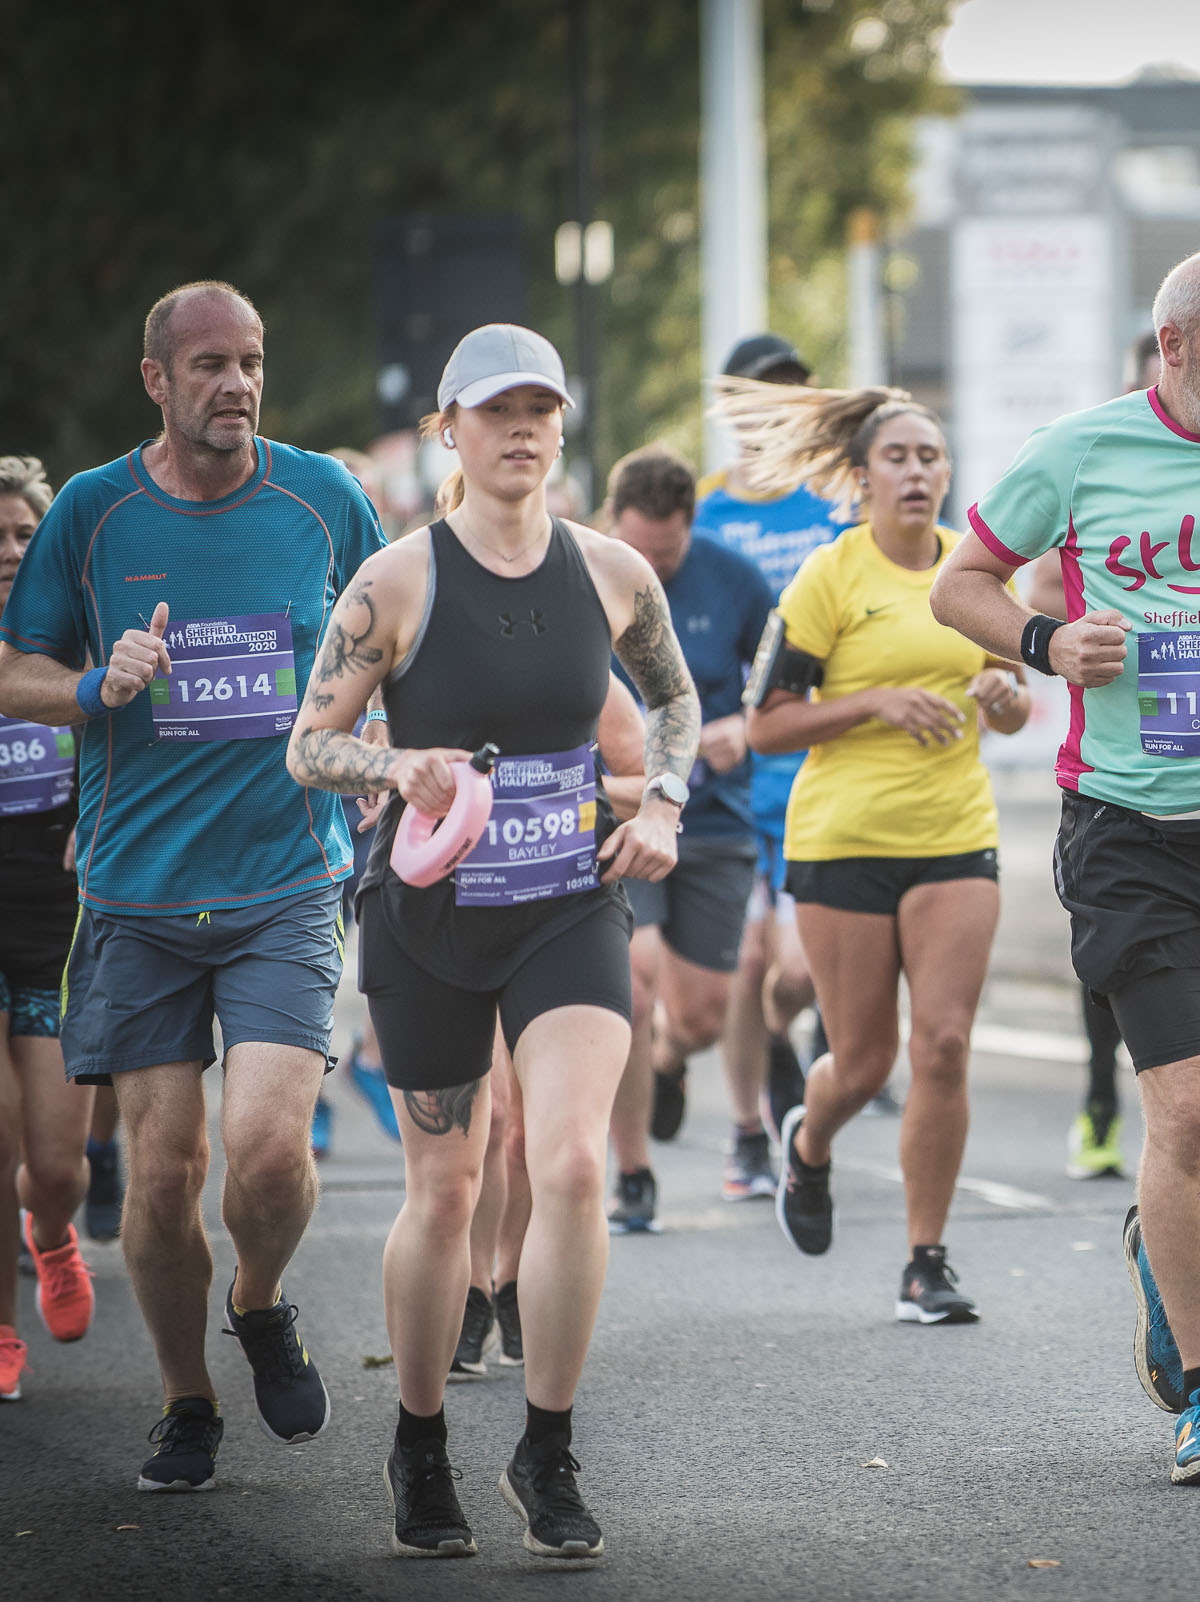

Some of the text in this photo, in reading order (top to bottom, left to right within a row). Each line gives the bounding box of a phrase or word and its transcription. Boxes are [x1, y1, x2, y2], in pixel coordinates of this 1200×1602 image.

[1105, 531, 1170, 591] St
[125, 573, 167, 582] MAMMUT
[187, 625, 235, 637] SHEFFIELD
[188, 631, 275, 647] HALF MARATHON
[249, 641, 277, 652] 2020
[178, 673, 272, 702] 12614
[500, 764, 550, 776] SHEFFIELD
[500, 766, 584, 788] HALF MARATHON
[559, 775, 584, 790] 2020
[487, 808, 575, 846] 10598
[508, 843, 557, 860] BAYLEY
[566, 875, 595, 890] 10598
